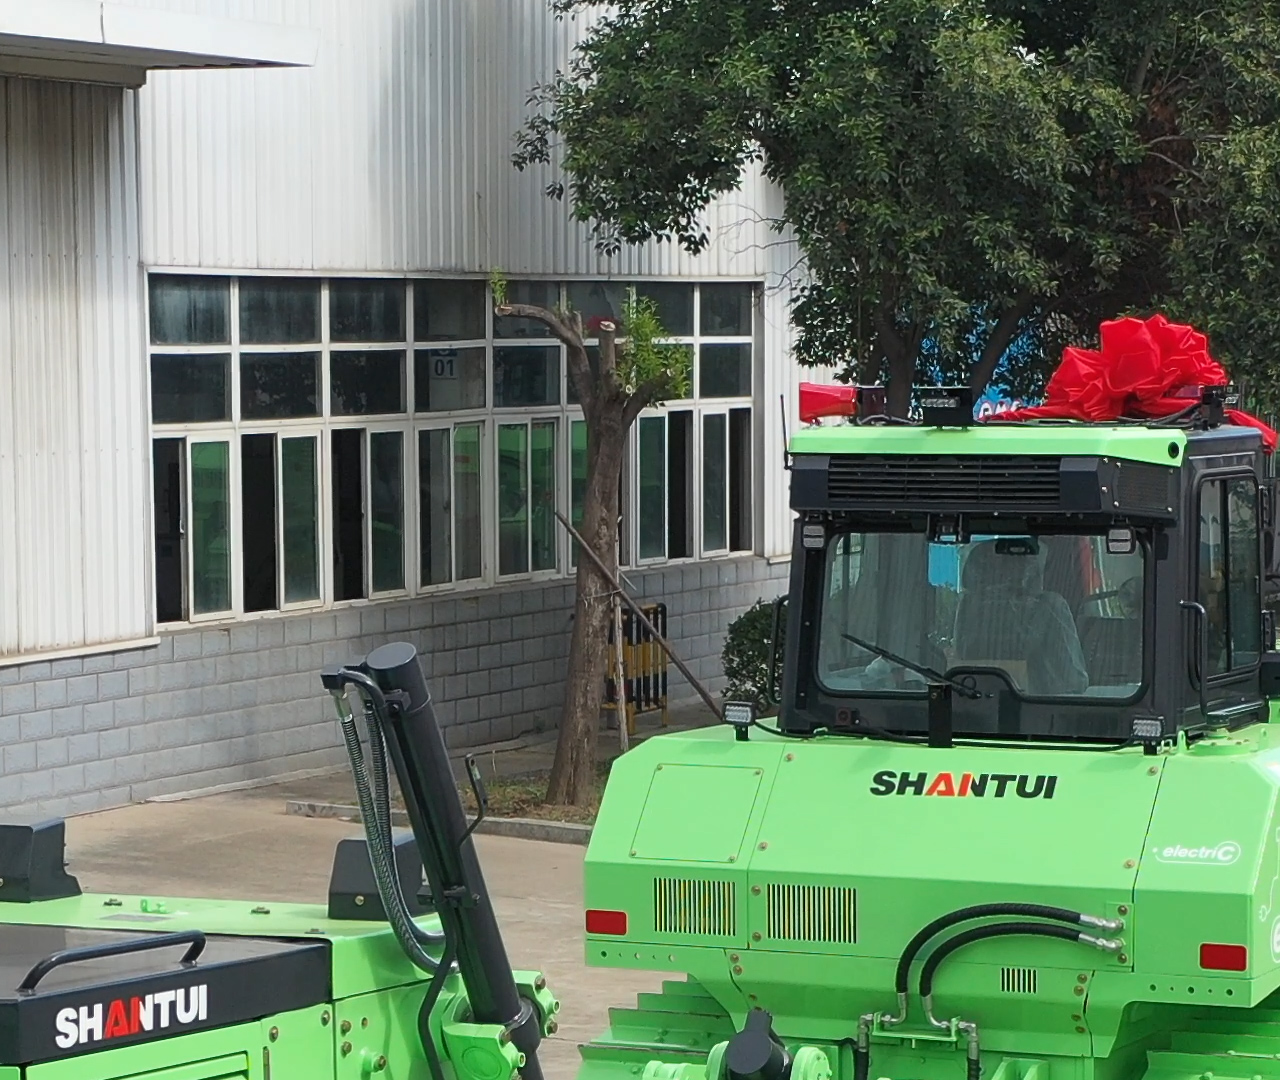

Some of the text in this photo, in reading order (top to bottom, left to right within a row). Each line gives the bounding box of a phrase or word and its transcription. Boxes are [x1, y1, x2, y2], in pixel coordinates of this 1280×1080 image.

[434, 359, 454, 376] 01
[869, 769, 1058, 800] SHANTUI
[55, 984, 209, 1049] SHANTUI
